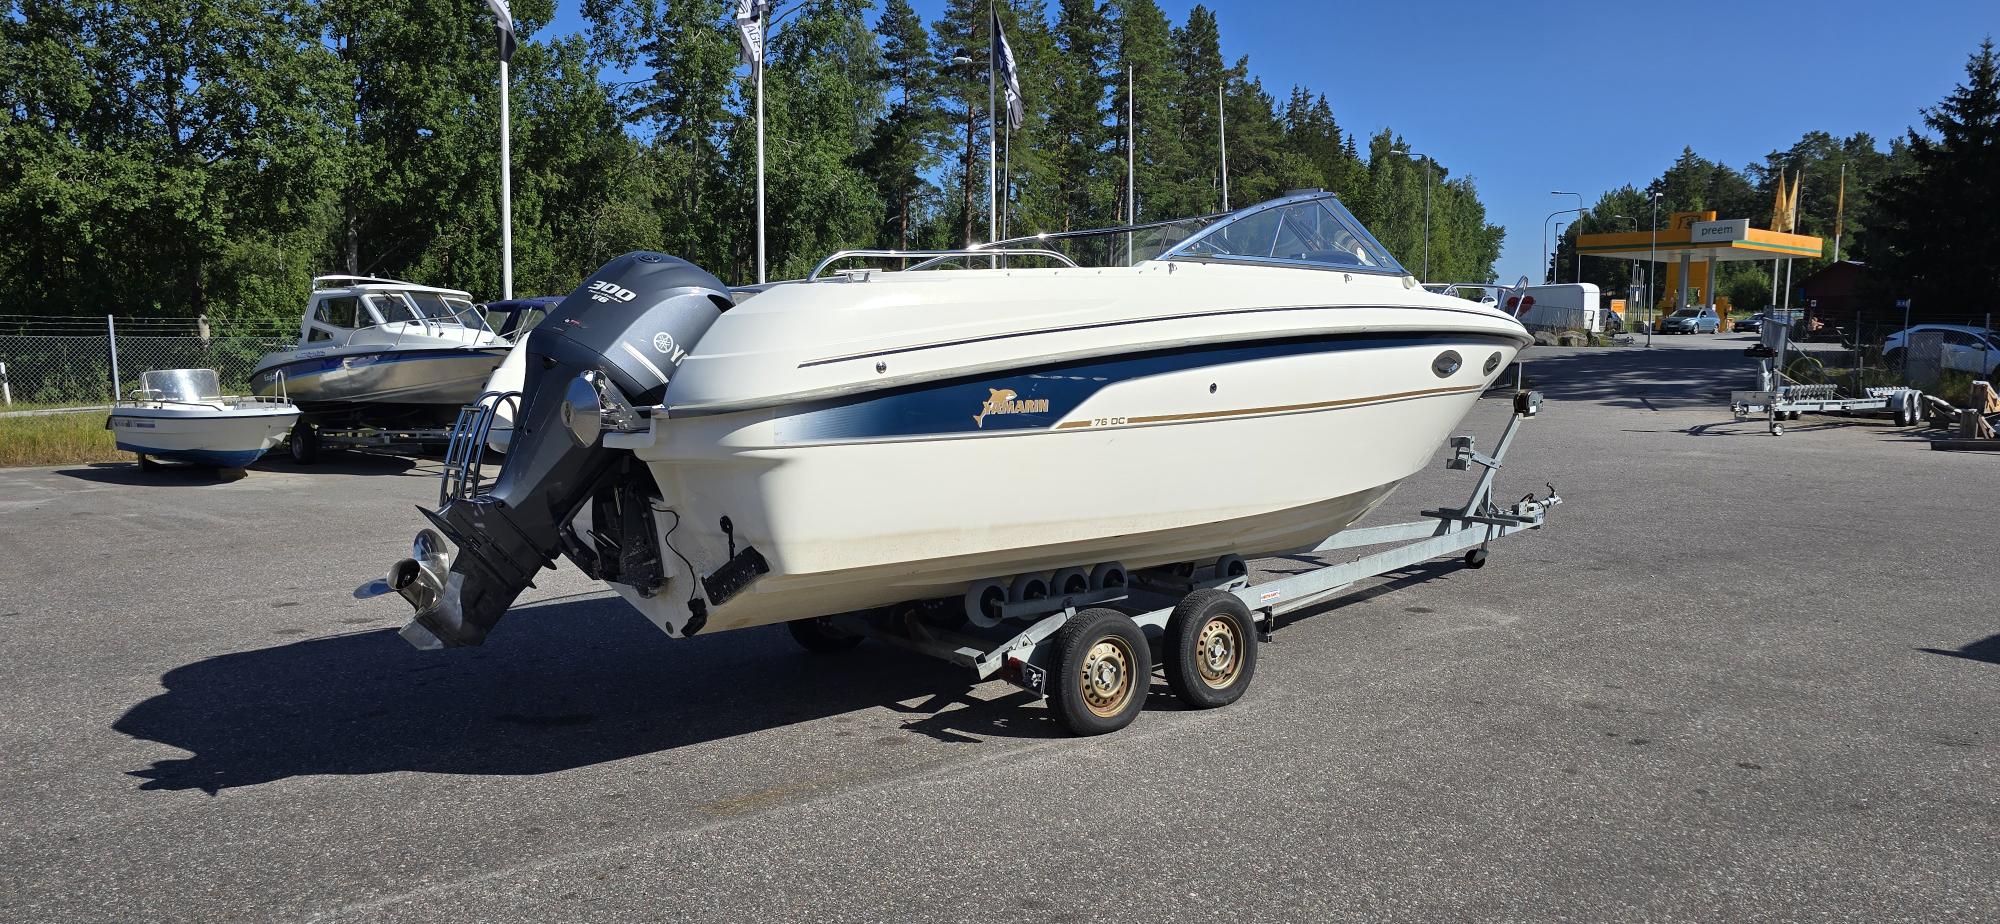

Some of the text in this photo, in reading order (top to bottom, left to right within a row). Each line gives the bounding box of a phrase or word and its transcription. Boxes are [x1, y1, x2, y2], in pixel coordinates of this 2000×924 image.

[1701, 226, 1733, 236] preem
[587, 280, 637, 302] 300
[591, 294, 609, 303] V6
[982, 399, 1049, 415] YAMARIN
[1094, 417, 1126, 427] 76 DC
